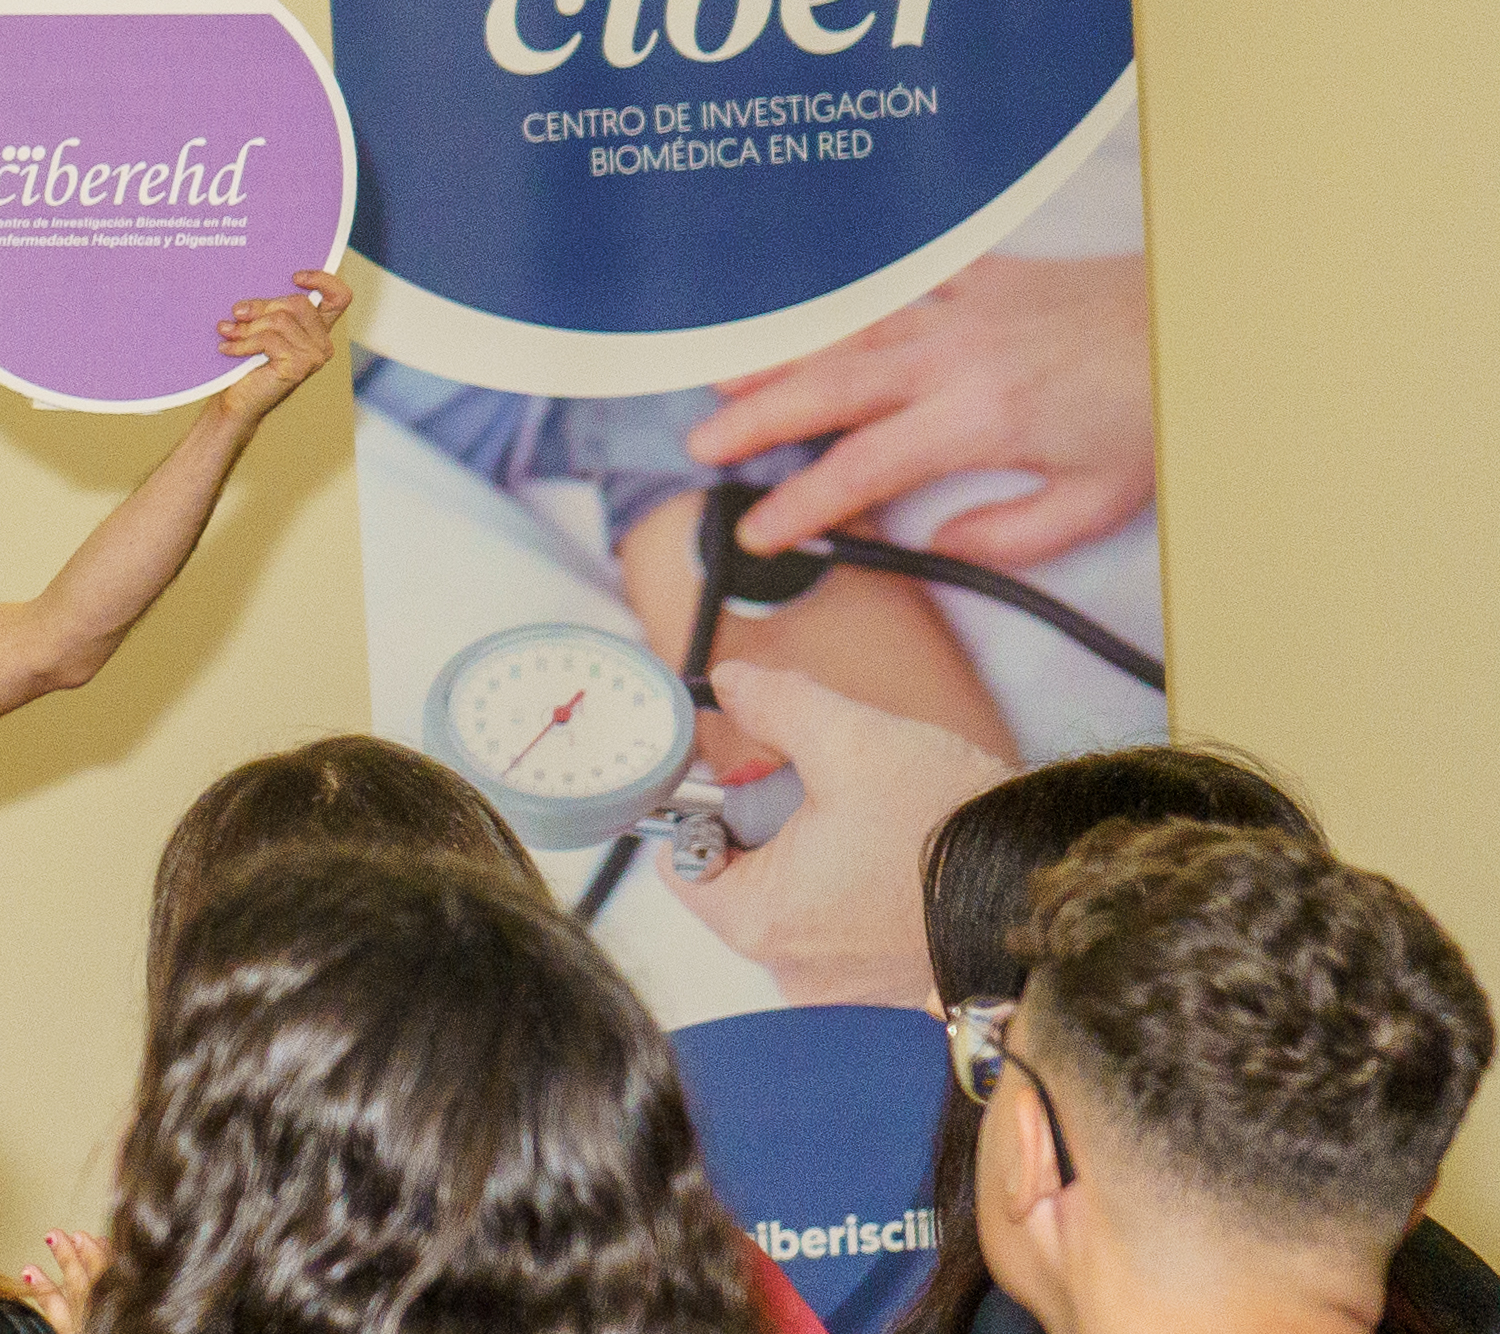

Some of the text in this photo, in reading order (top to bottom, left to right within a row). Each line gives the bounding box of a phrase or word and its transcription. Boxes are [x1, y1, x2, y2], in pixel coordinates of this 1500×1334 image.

[524, 81, 937, 143] CENTRO DE INVESTIGACIÓN
[591, 128, 872, 176] BIOMÉDICA EN RED
[33, 217, 48, 229] de
[51, 217, 132, 230] Investigación
[136, 217, 200, 229] Biomédica
[203, 219, 219, 229] en
[222, 217, 247, 229] Red
[91, 234, 161, 248] Hepáticas
[175, 233, 247, 249] Digestivas
